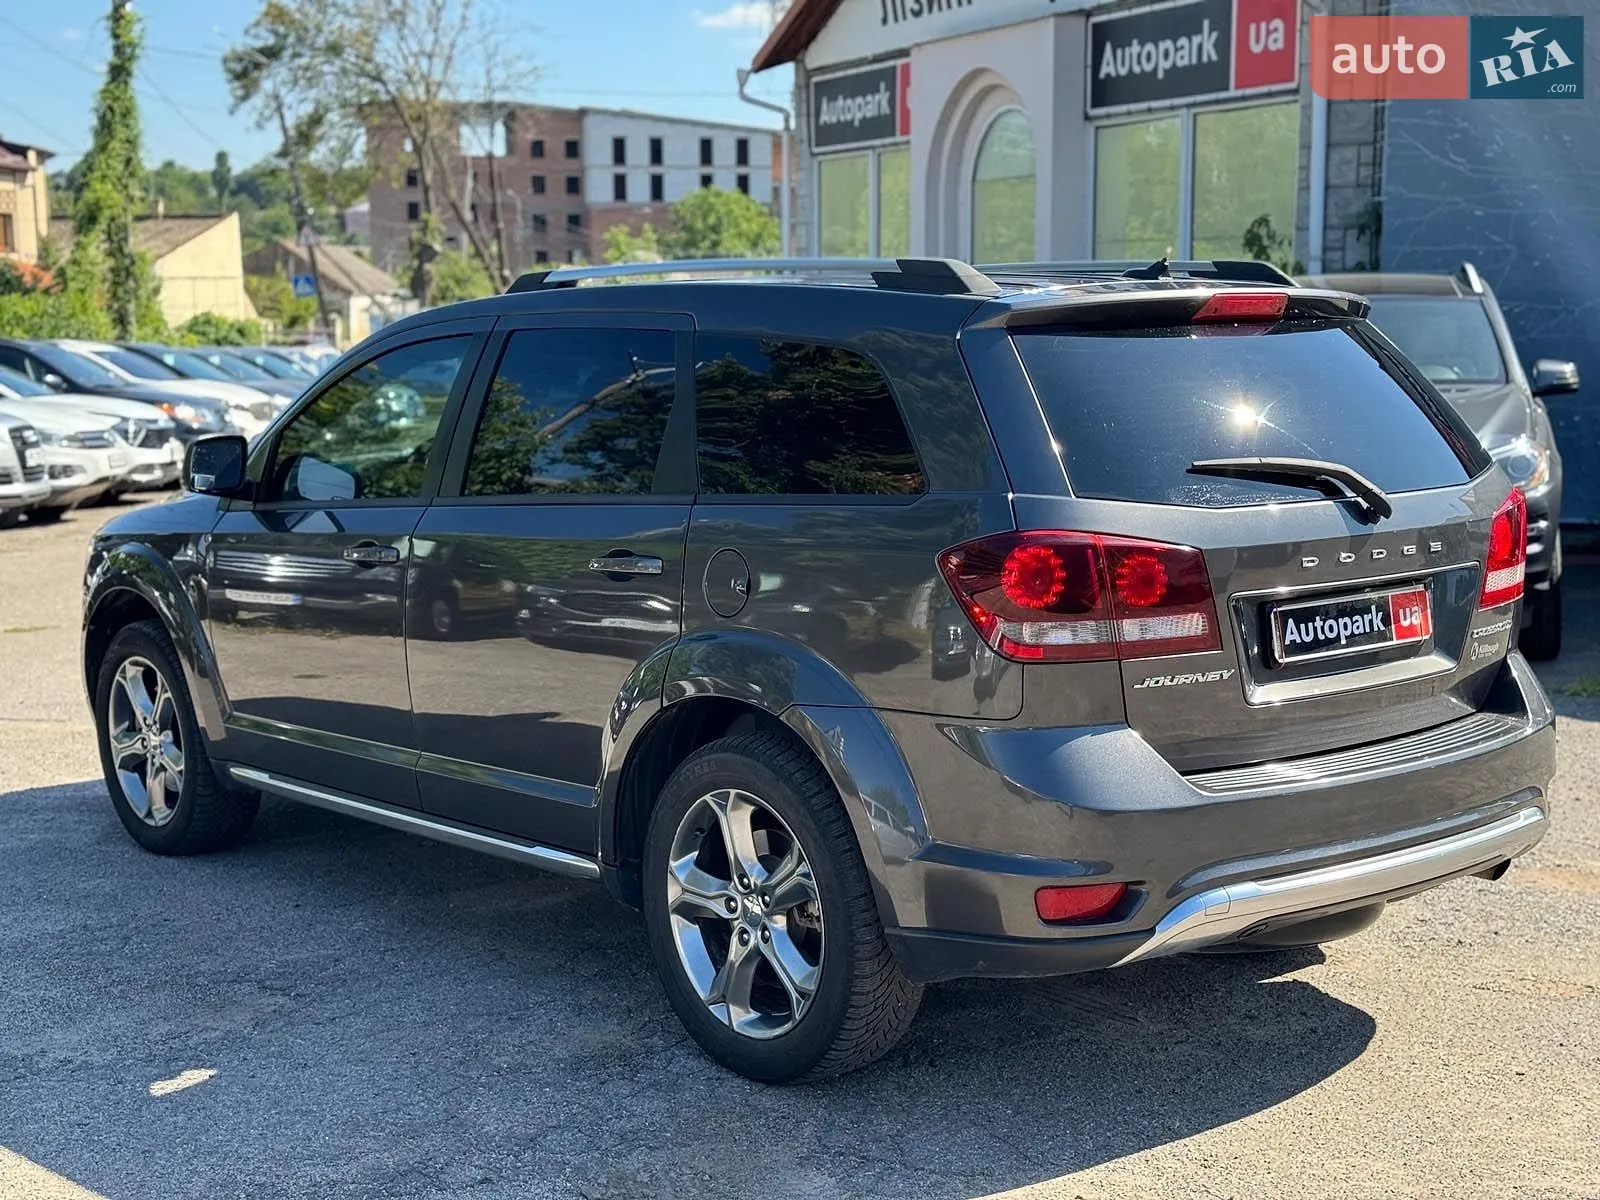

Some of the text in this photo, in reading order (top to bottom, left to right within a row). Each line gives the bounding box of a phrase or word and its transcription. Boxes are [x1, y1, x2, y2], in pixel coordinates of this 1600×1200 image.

[1099, 18, 1285, 80] Autopark ua
[819, 81, 891, 128] Autopark
[1301, 541, 1442, 568] DODGE
[1284, 605, 1422, 646] Autopark ua
[1133, 668, 1236, 689] JOURNEY
